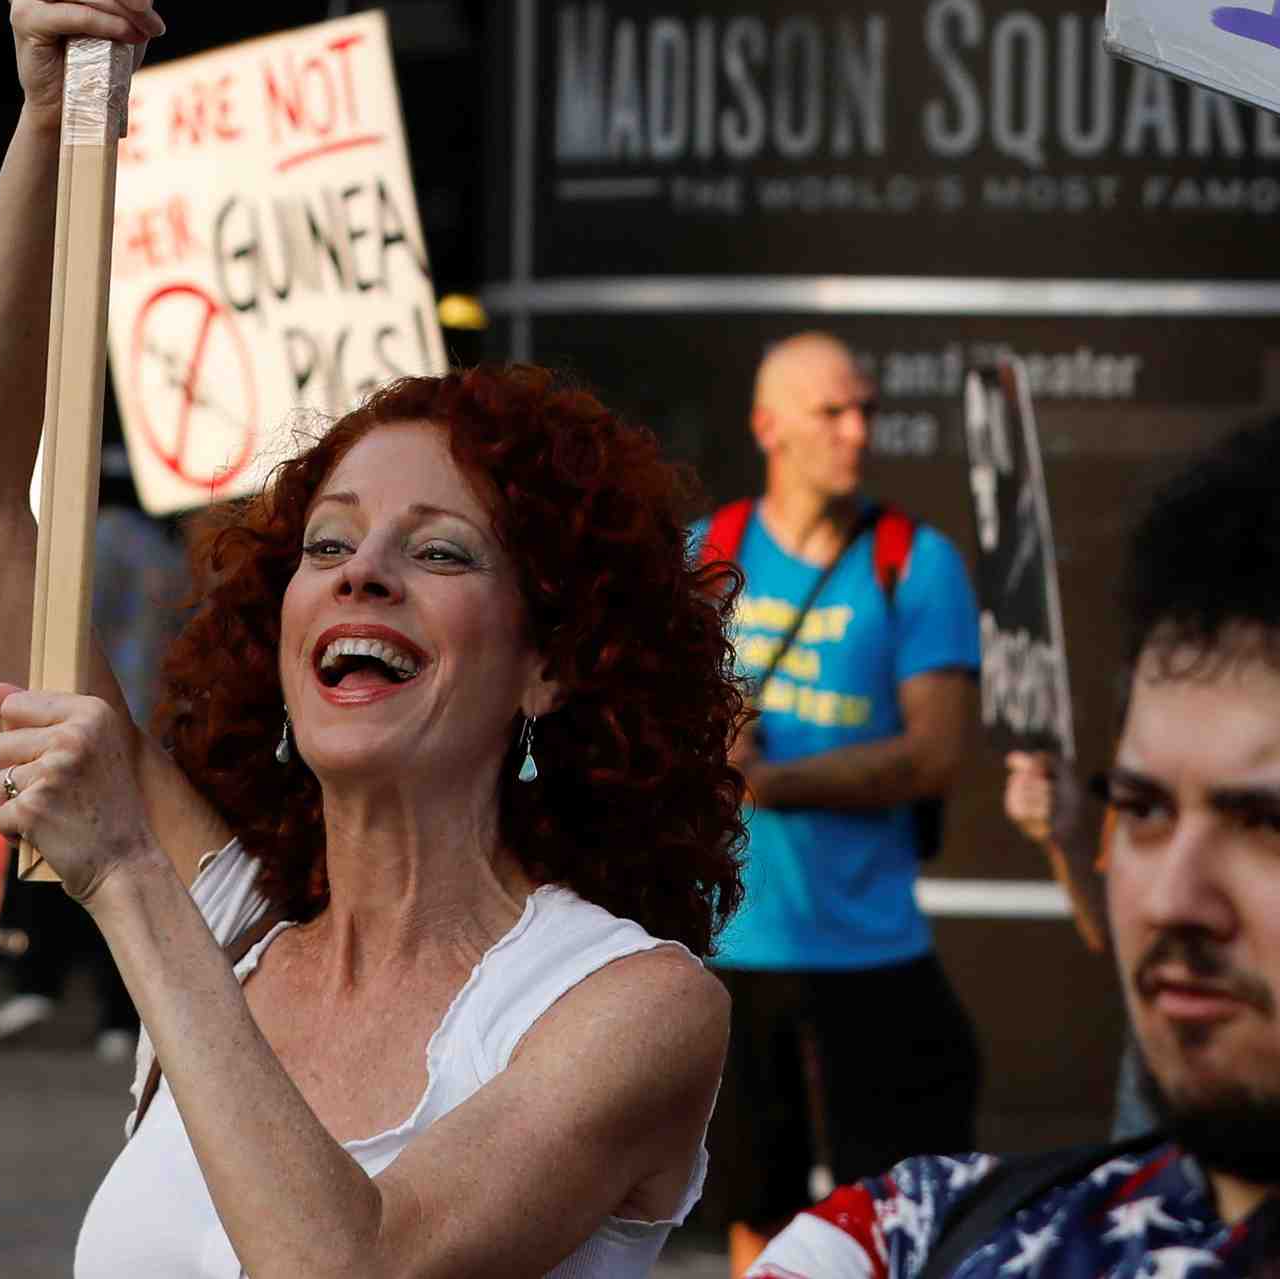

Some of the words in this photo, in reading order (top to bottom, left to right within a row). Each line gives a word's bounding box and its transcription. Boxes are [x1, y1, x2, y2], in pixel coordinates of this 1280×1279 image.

[262, 34, 366, 148] NOT
[212, 178, 416, 322] GUINEA
[983, 175, 1120, 211] MOST
